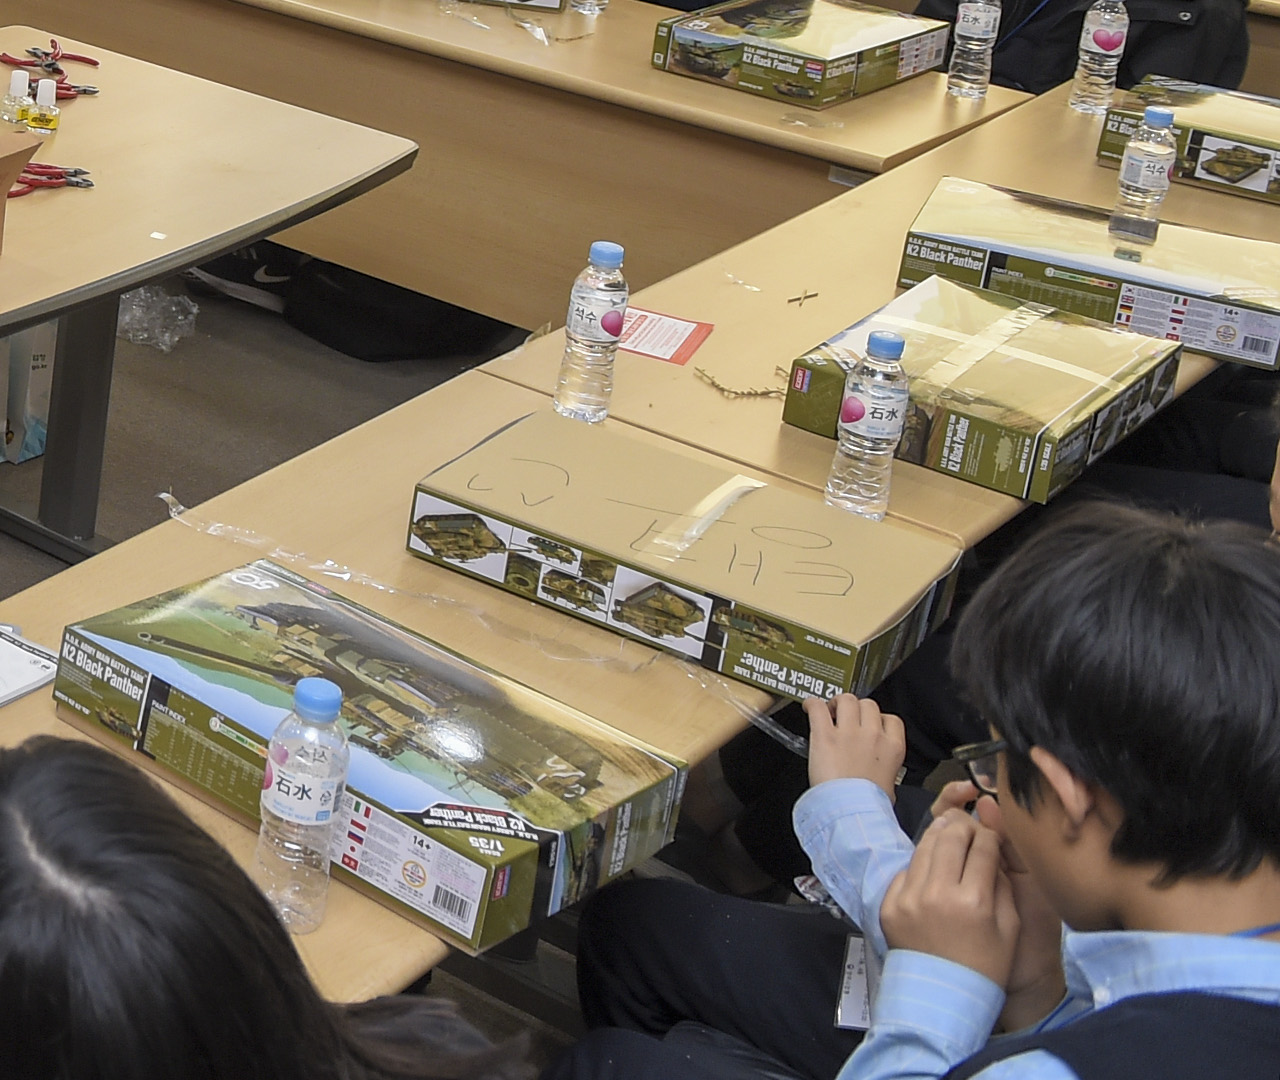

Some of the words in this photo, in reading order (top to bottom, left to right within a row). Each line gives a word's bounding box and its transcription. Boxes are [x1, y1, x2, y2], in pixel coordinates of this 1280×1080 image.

[961, 13, 981, 25] 石水
[742, 51, 753, 63] K2
[753, 54, 773, 68] Black
[773, 58, 801, 75] Panther
[1145, 162, 1167, 175] 석수
[906, 243, 919, 256] K2
[919, 246, 945, 264] Black
[946, 250, 984, 271] Panther
[575, 306, 597, 323] 석수
[1223, 307, 1239, 317] 14+
[869, 406, 899, 422] 石水
[949, 441, 965, 463] Black
[62, 642, 77, 664] K2
[75, 649, 103, 680] Black
[103, 665, 144, 702] Panther
[80, 642, 97, 657] ARMY
[96, 649, 111, 665] MAIN
[111, 657, 130, 679] BATTLE
[130, 669, 146, 685] TANK
[733, 664, 751, 679] TANK
[751, 672, 778, 689] BATTLE
[790, 669, 825, 697] Black
[275, 774, 313, 801] 石水
[429, 807, 475, 824] Panther
[475, 811, 508, 827] Black
[509, 816, 526, 832] K2
[412, 835, 432, 851] 14+
[468, 836, 506, 852] 1/35
